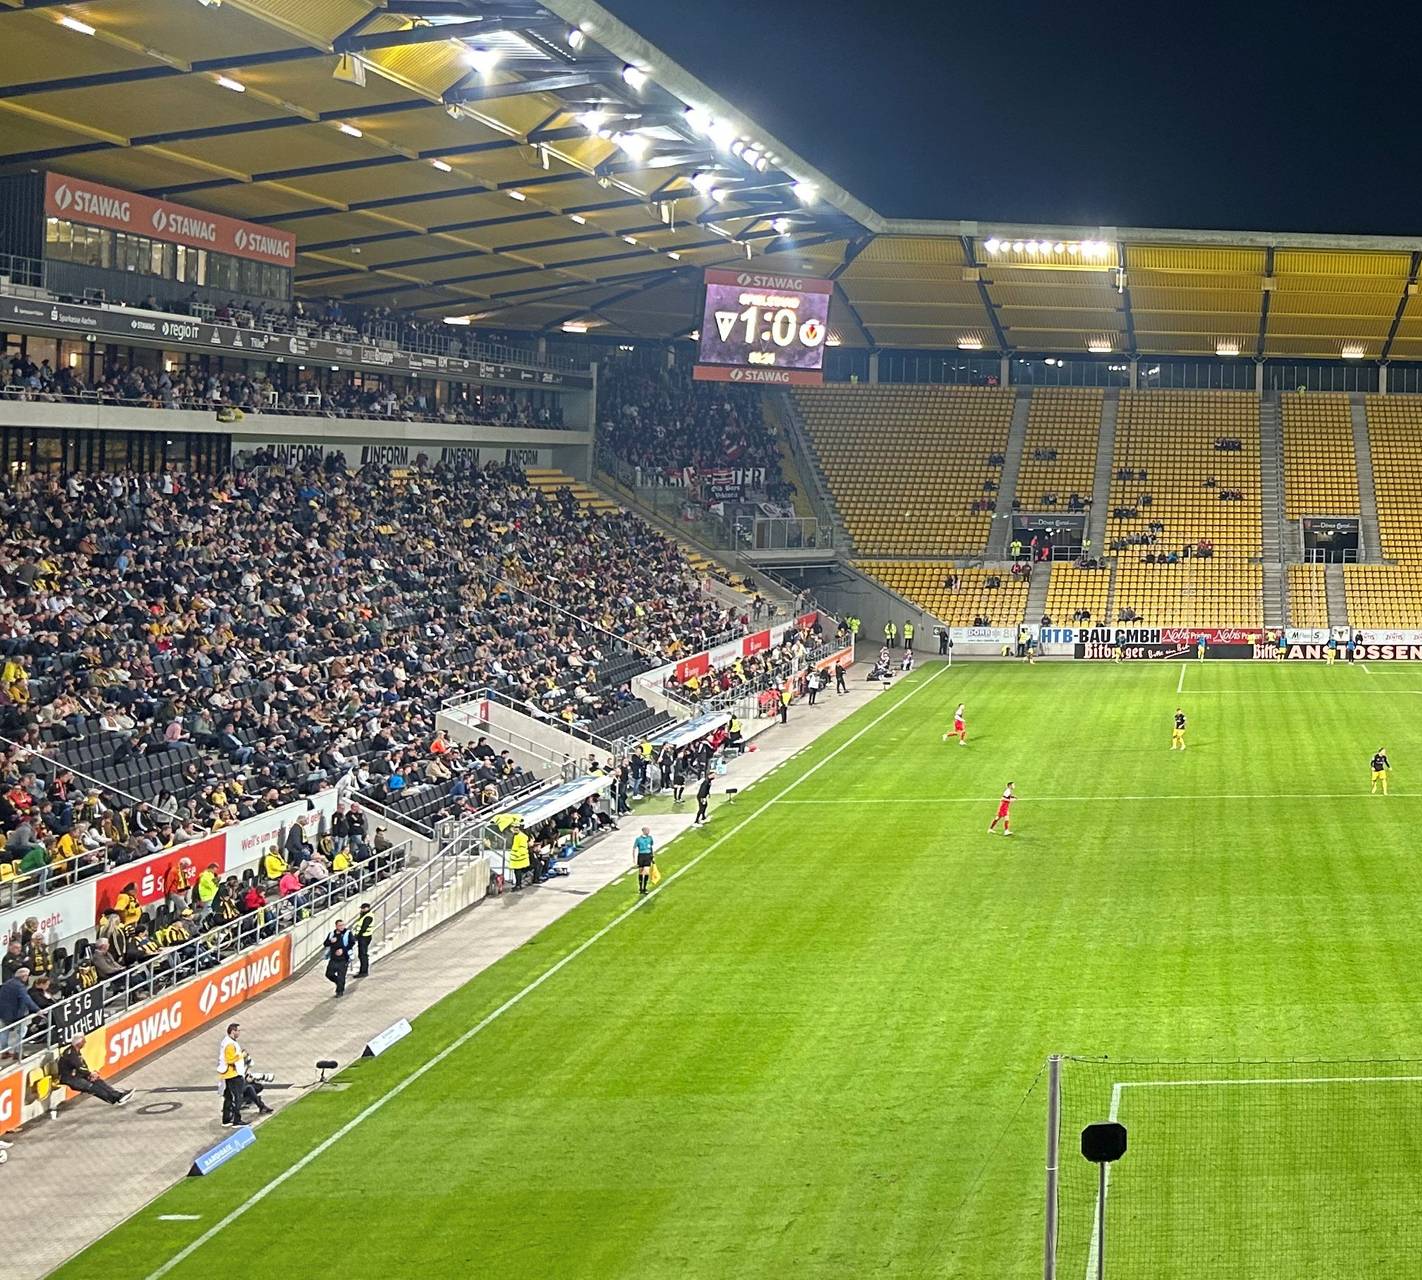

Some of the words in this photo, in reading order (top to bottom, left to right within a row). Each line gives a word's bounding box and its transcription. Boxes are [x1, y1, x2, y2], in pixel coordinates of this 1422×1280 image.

[75, 190, 130, 222] STAWAG
[169, 215, 216, 242] STAWAG
[249, 234, 290, 258] STAWAG
[753, 275, 802, 290] STAWAG
[745, 370, 790, 382] STAWAG
[371, 446, 409, 466] INFORM
[511, 450, 538, 465] INFORM
[1041, 629, 1110, 643] HTB-BAU
[220, 950, 280, 1003] STAWAG
[109, 1001, 182, 1065] STAWAG
